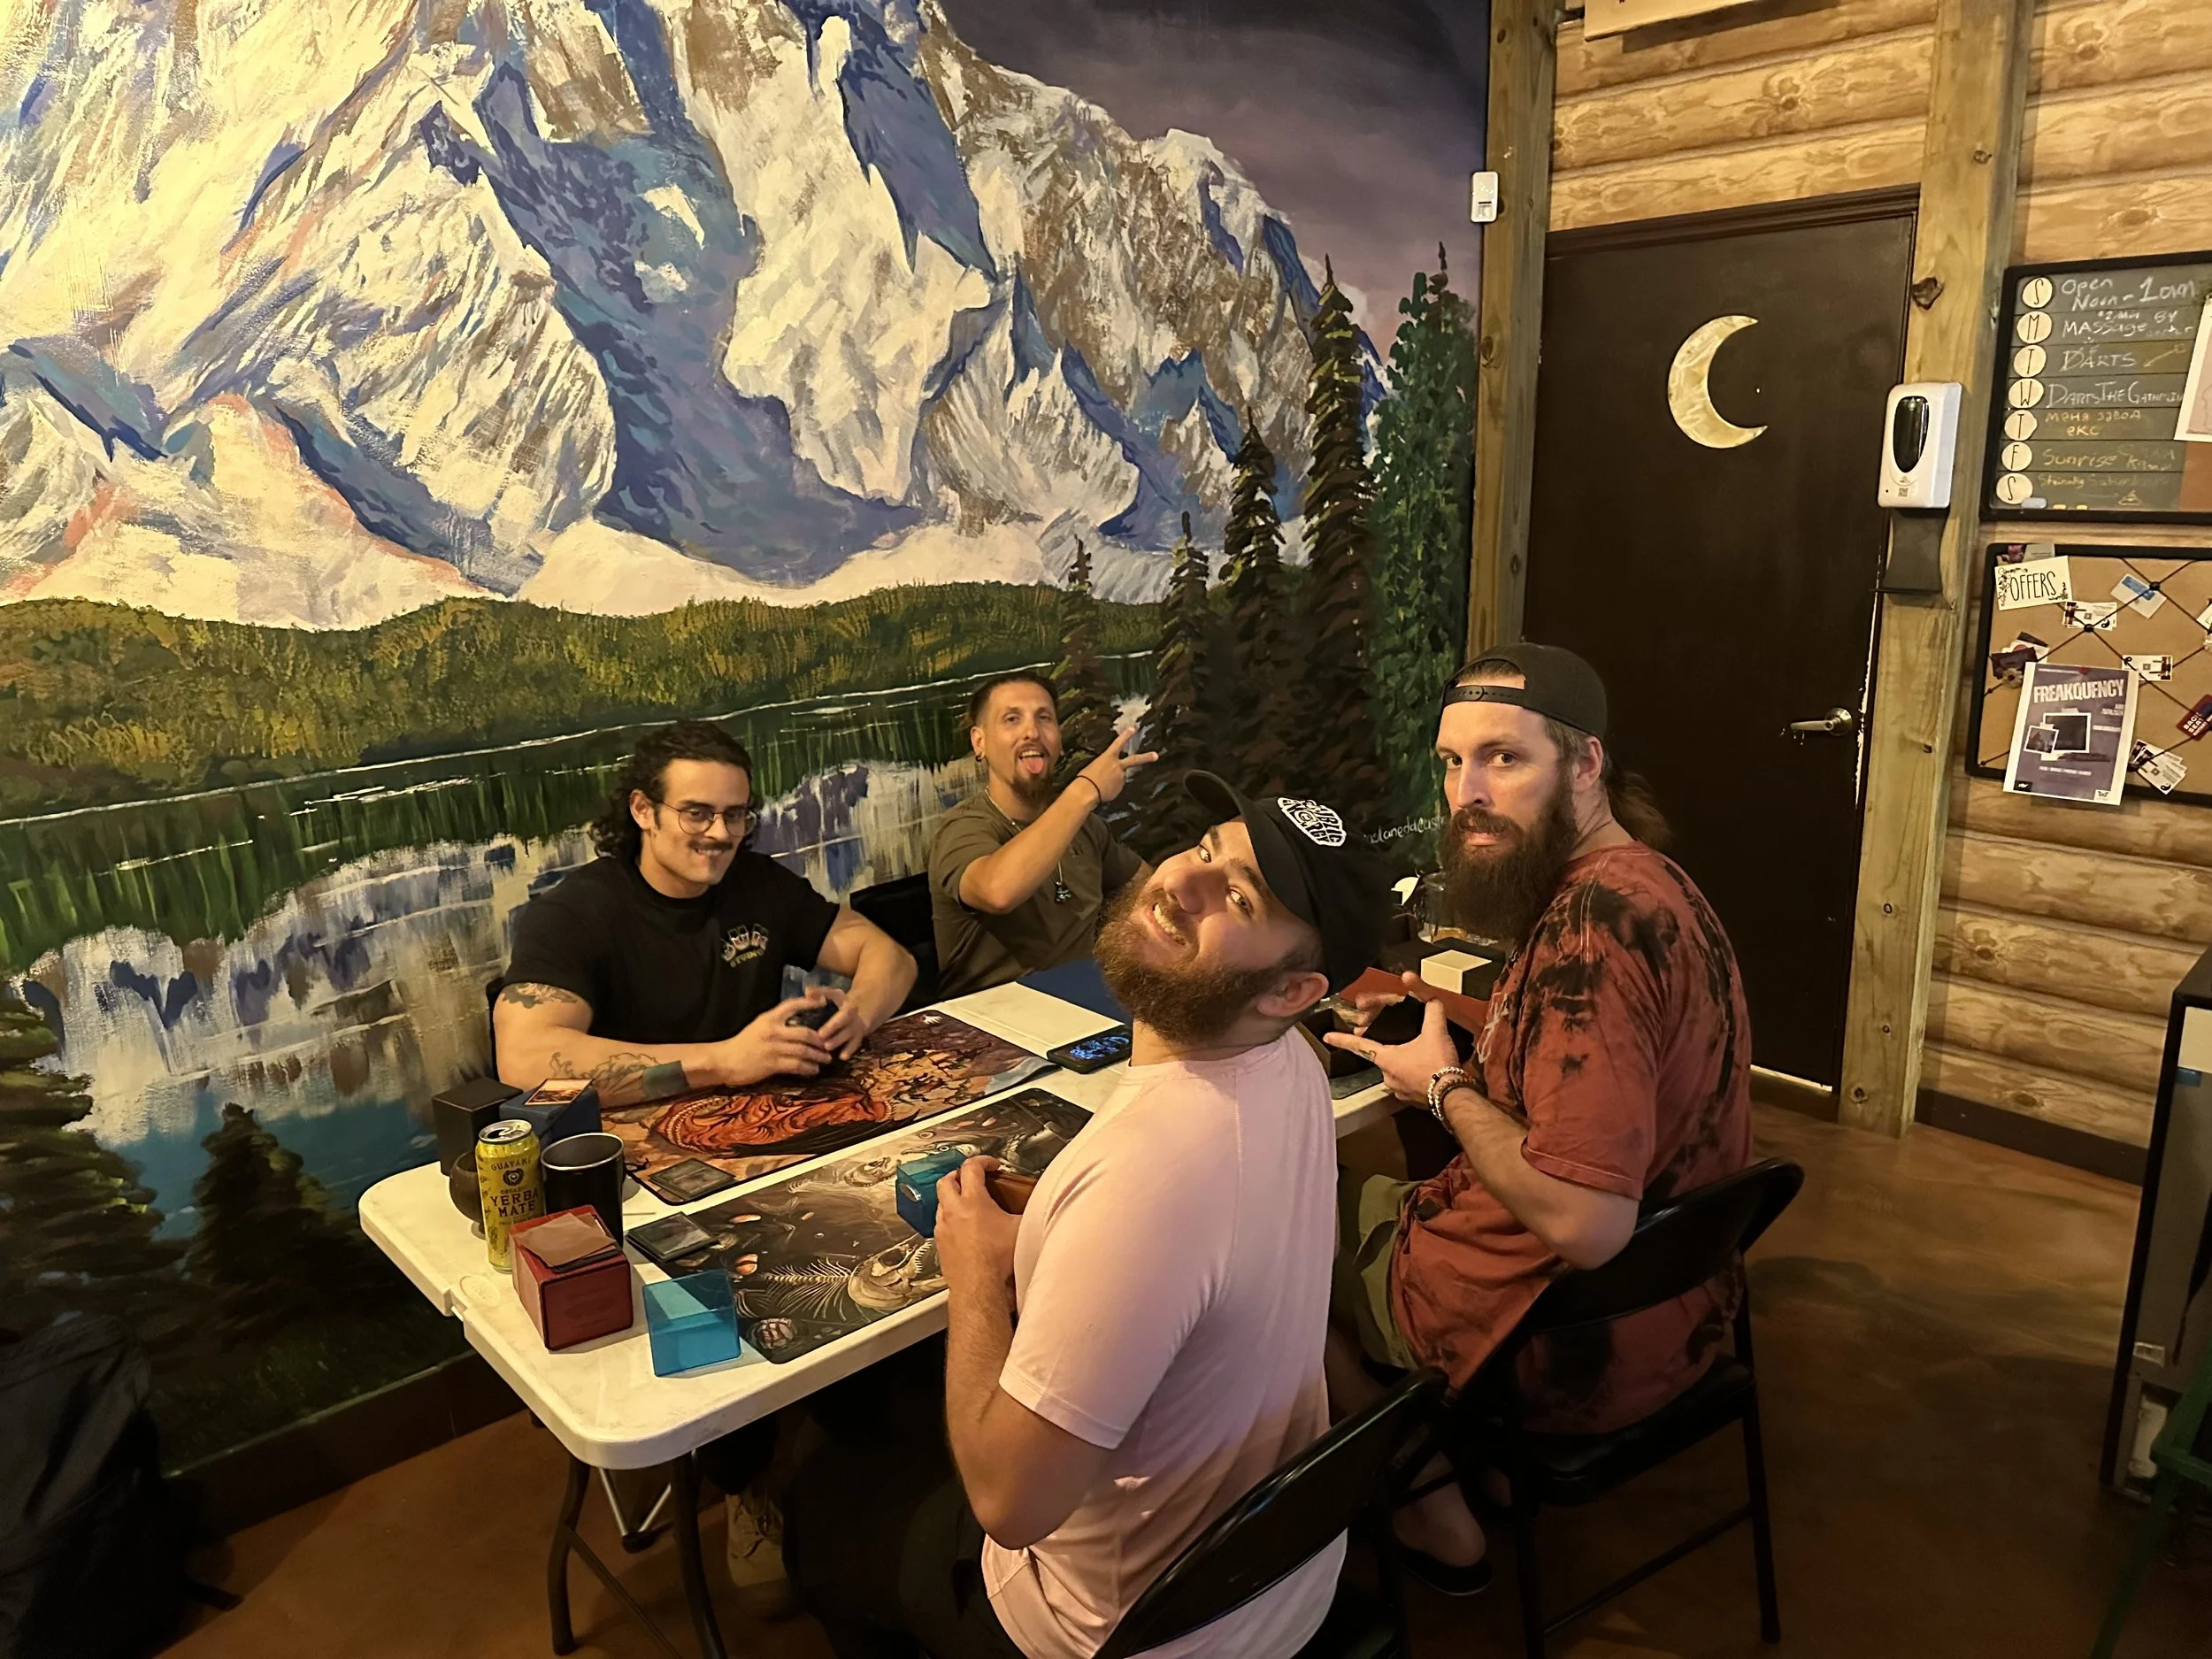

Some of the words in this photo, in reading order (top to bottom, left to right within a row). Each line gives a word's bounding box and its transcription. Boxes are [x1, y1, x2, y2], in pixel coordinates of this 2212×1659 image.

[2033, 278, 2044, 305] S
[2061, 278, 2114, 296] Open
[2072, 294, 2117, 311] Noon
[2027, 314, 2039, 341] M
[2027, 349, 2035, 374] T
[2020, 380, 2032, 406] W
[2017, 414, 2024, 439] T
[2010, 445, 2019, 470] F
[2042, 449, 2117, 468] Sunrise
[2007, 476, 2016, 501] S
[2009, 571, 2056, 601] OFFERS
[2033, 679, 2124, 703] FREAKQUENCY
[490, 1188, 539, 1207] YERBA
[498, 1200, 535, 1217] MATE
